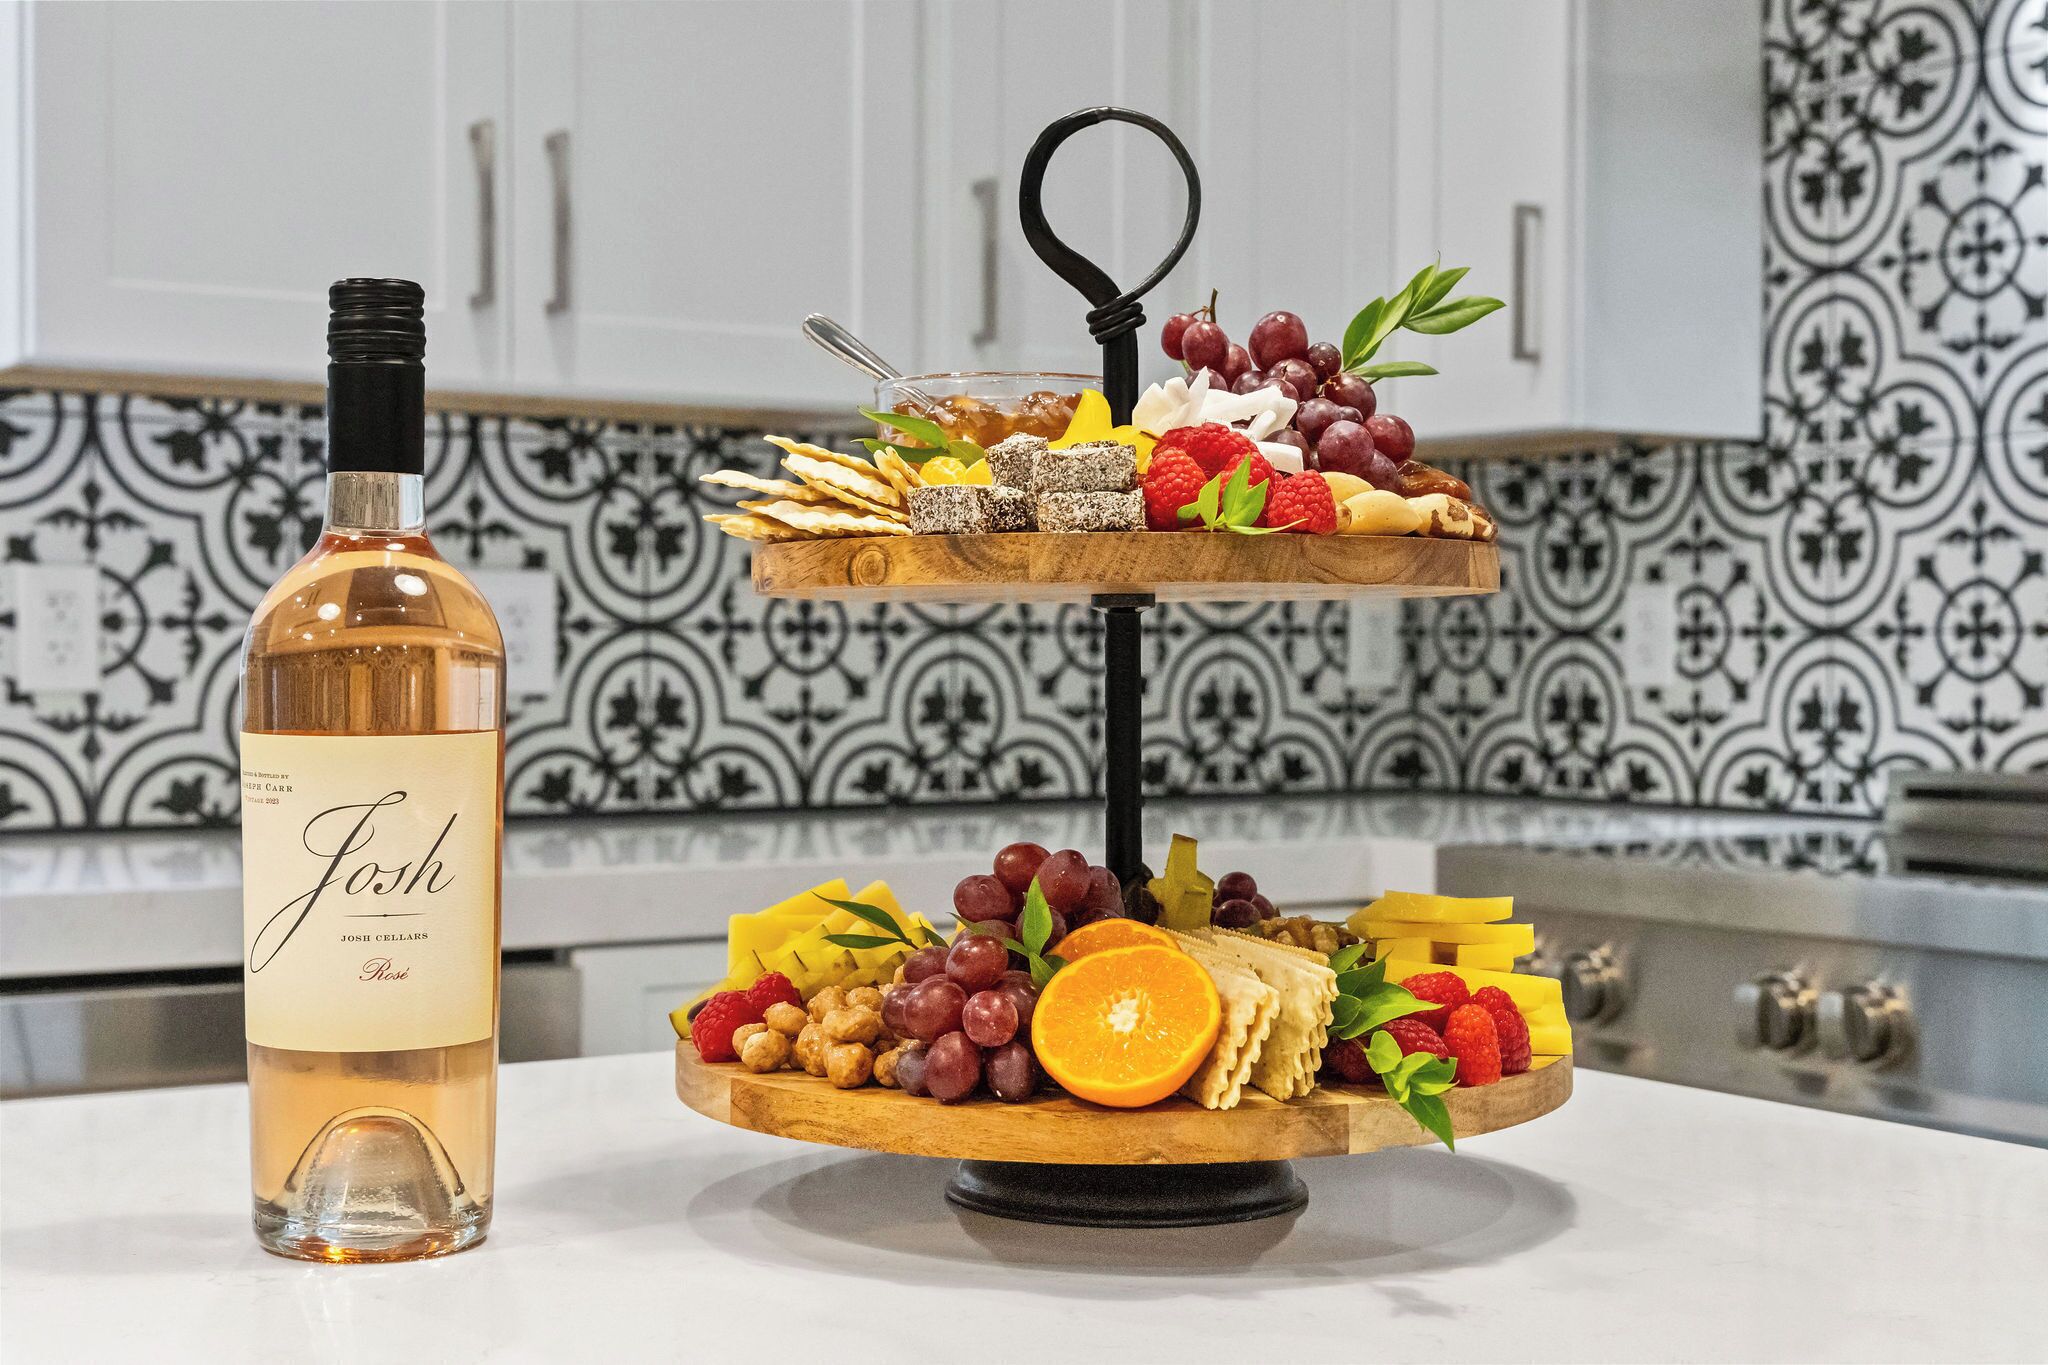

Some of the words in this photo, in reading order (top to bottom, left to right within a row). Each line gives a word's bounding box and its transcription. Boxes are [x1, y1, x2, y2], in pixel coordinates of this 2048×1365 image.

[265, 783, 293, 792] CARR
[250, 790, 458, 973] Josh
[340, 934, 372, 943] JOSH
[375, 932, 429, 943] CELLARS
[359, 957, 410, 981] Rosé
